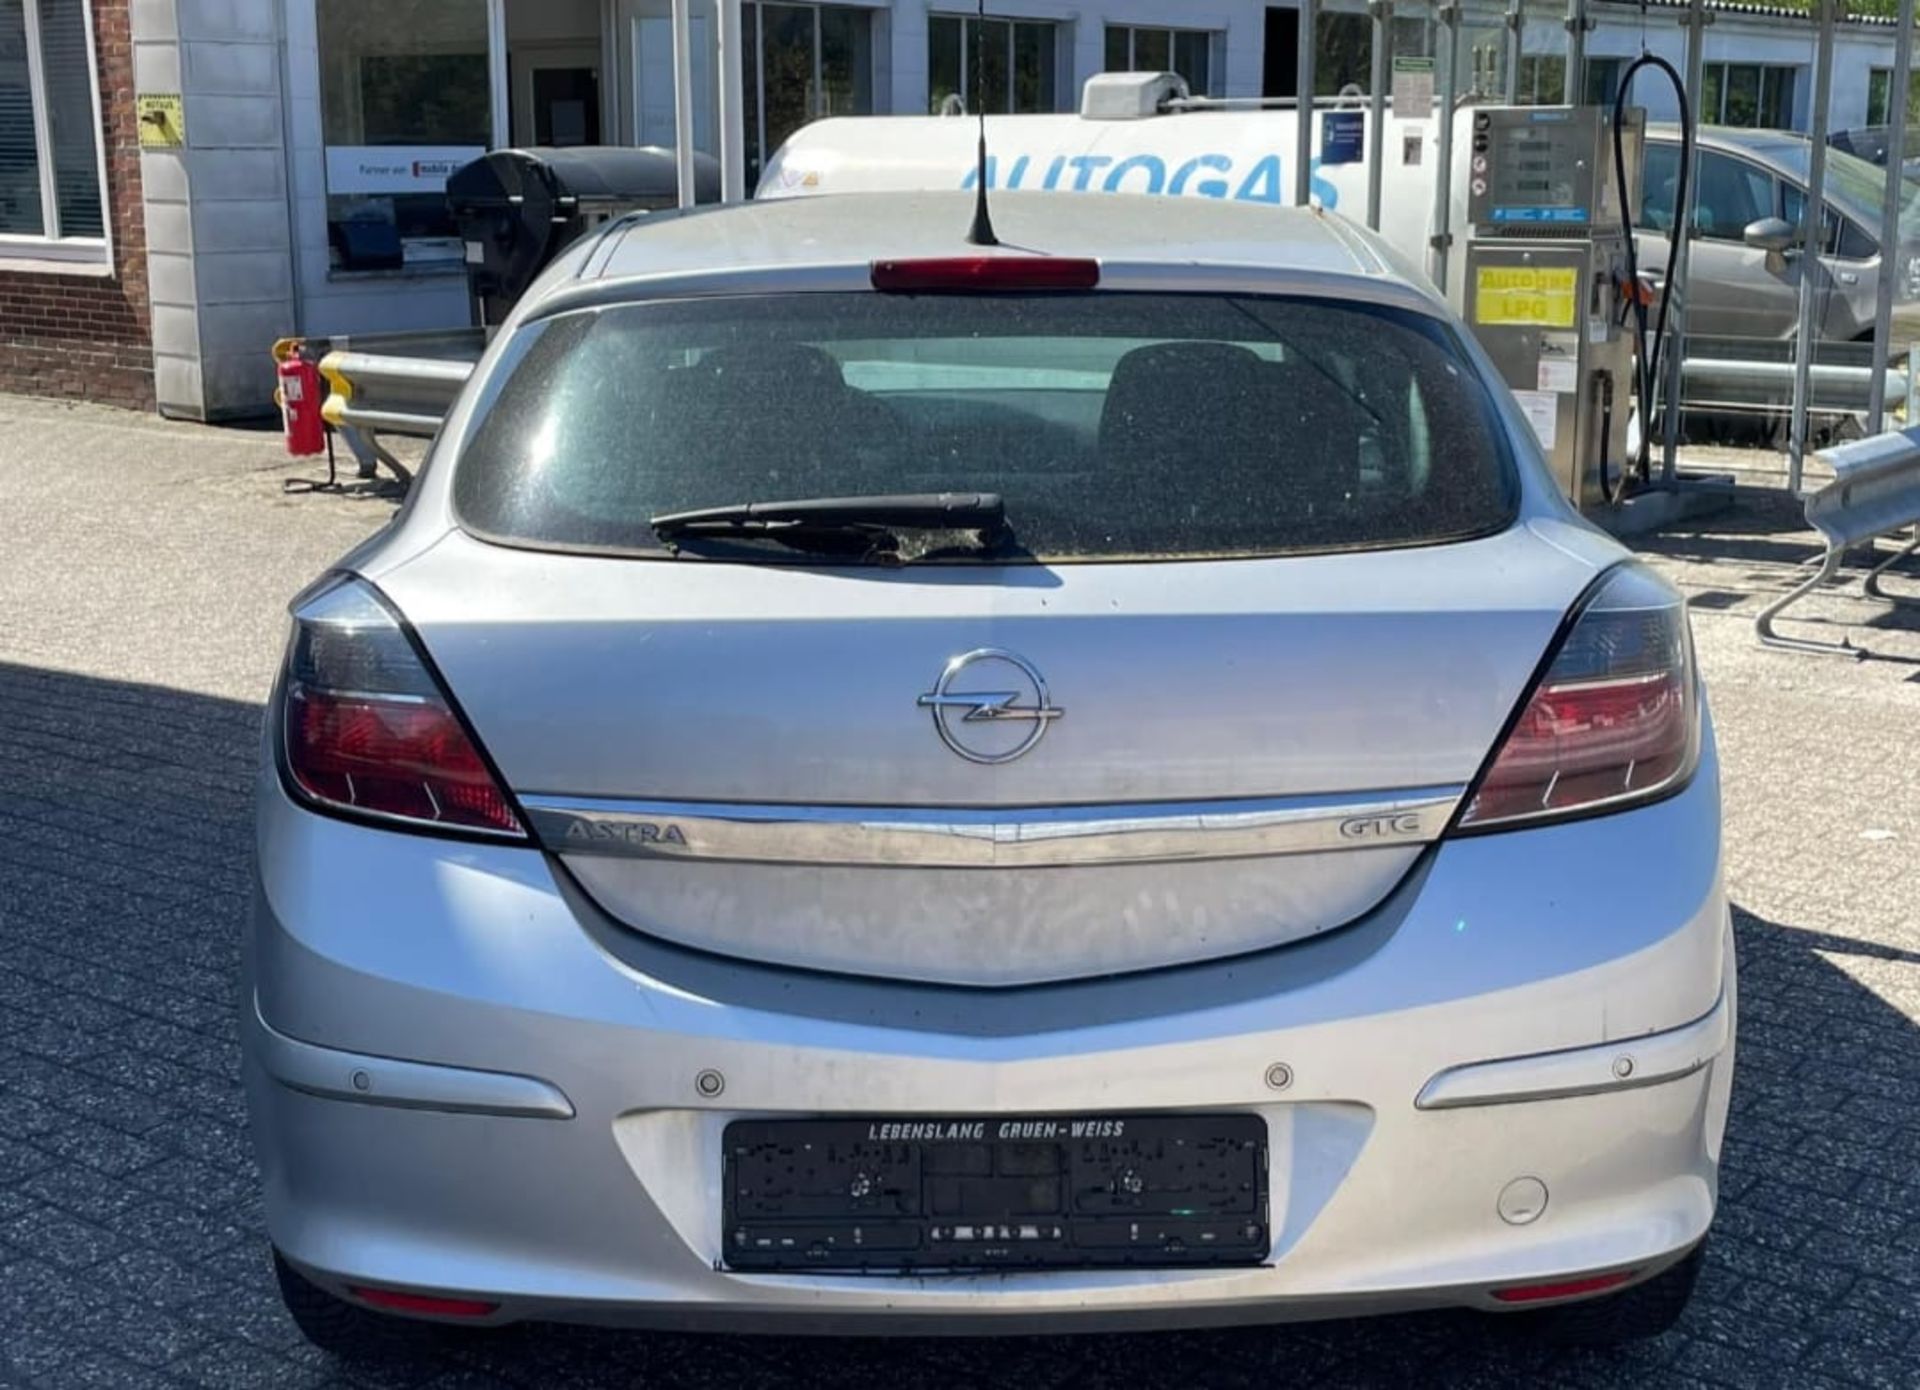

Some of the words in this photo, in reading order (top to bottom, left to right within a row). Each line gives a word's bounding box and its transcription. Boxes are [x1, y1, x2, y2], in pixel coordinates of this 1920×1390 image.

[1502, 299, 1547, 318] LPG
[566, 820, 688, 845] ASTRA
[1340, 814, 1420, 837] GTC
[868, 1123, 984, 1140] LEBENSLANG
[998, 1121, 1125, 1138] GRUEN-WEISS
